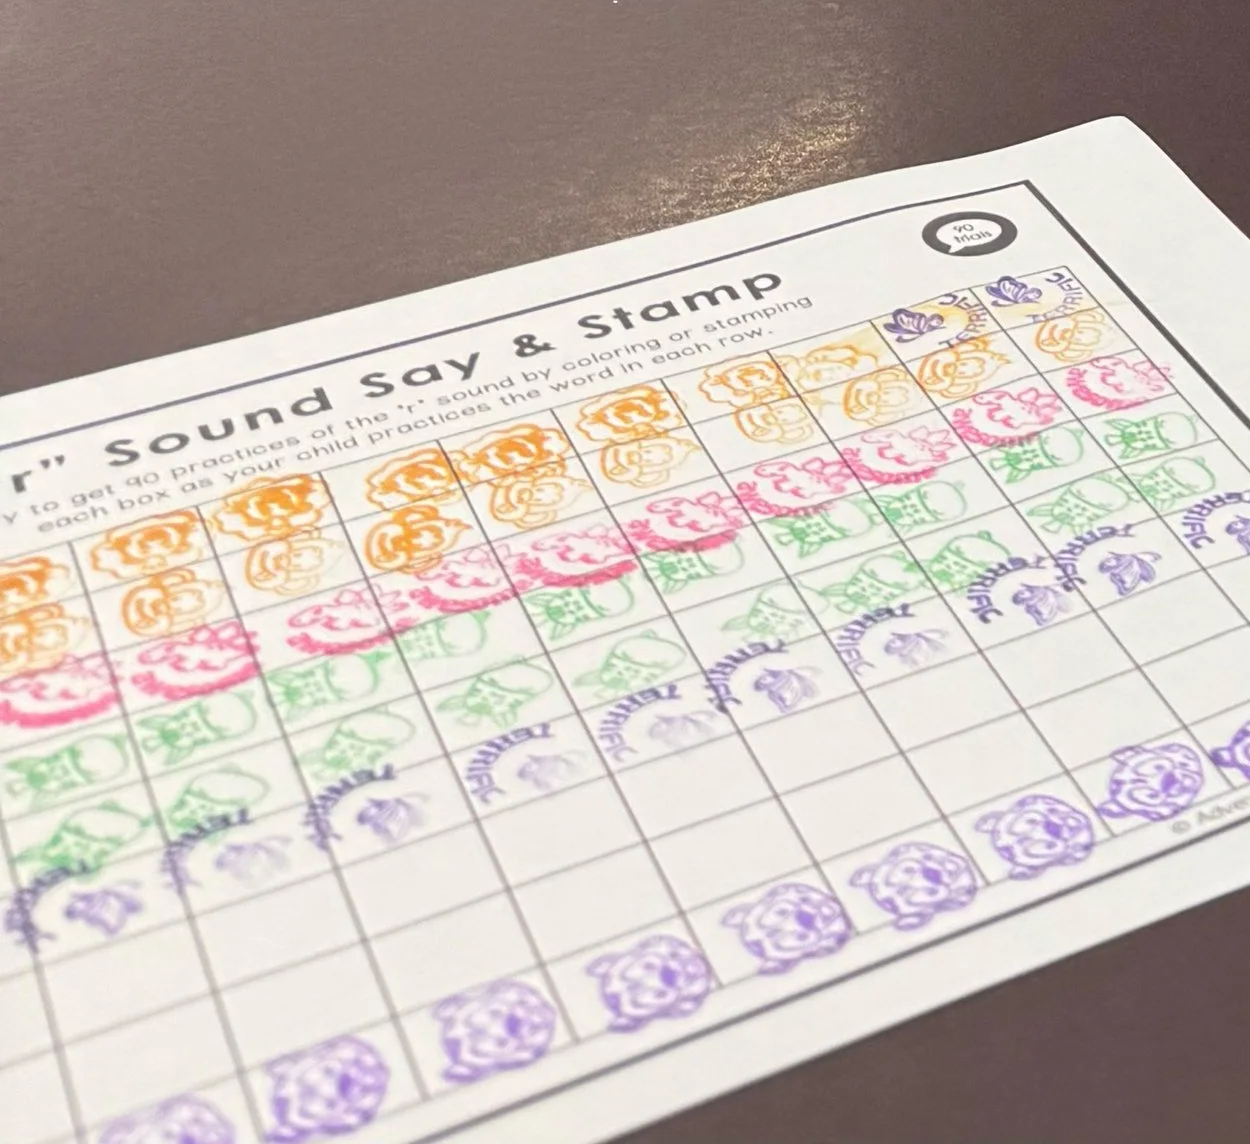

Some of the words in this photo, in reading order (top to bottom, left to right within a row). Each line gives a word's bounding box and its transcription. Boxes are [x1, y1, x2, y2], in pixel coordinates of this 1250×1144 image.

[953, 223, 974, 233] 90
[953, 231, 993, 244] trials
[30, 500, 60, 517] to
[71, 483, 116, 507] get
[125, 472, 160, 489] 90
[171, 435, 301, 481] practices
[311, 418, 339, 440] of
[346, 409, 390, 432] the
[437, 376, 515, 405] sound
[521, 367, 553, 388] by
[561, 336, 662, 374] coloring
[669, 327, 695, 345] or
[703, 296, 814, 333] stamping
[37, 502, 110, 533] each
[118, 486, 171, 509] box
[181, 475, 214, 493] as
[224, 457, 287, 484] your
[296, 436, 358, 462] child
[369, 400, 491, 445] practices
[501, 386, 541, 409] the
[549, 362, 615, 395] word
[622, 359, 645, 376] in
[652, 339, 713, 367] each
[719, 327, 775, 348] row.
[104, 386, 334, 467] Sound
[359, 351, 481, 399] Say
[512, 334, 557, 359] &
[577, 271, 782, 339] Stamp
